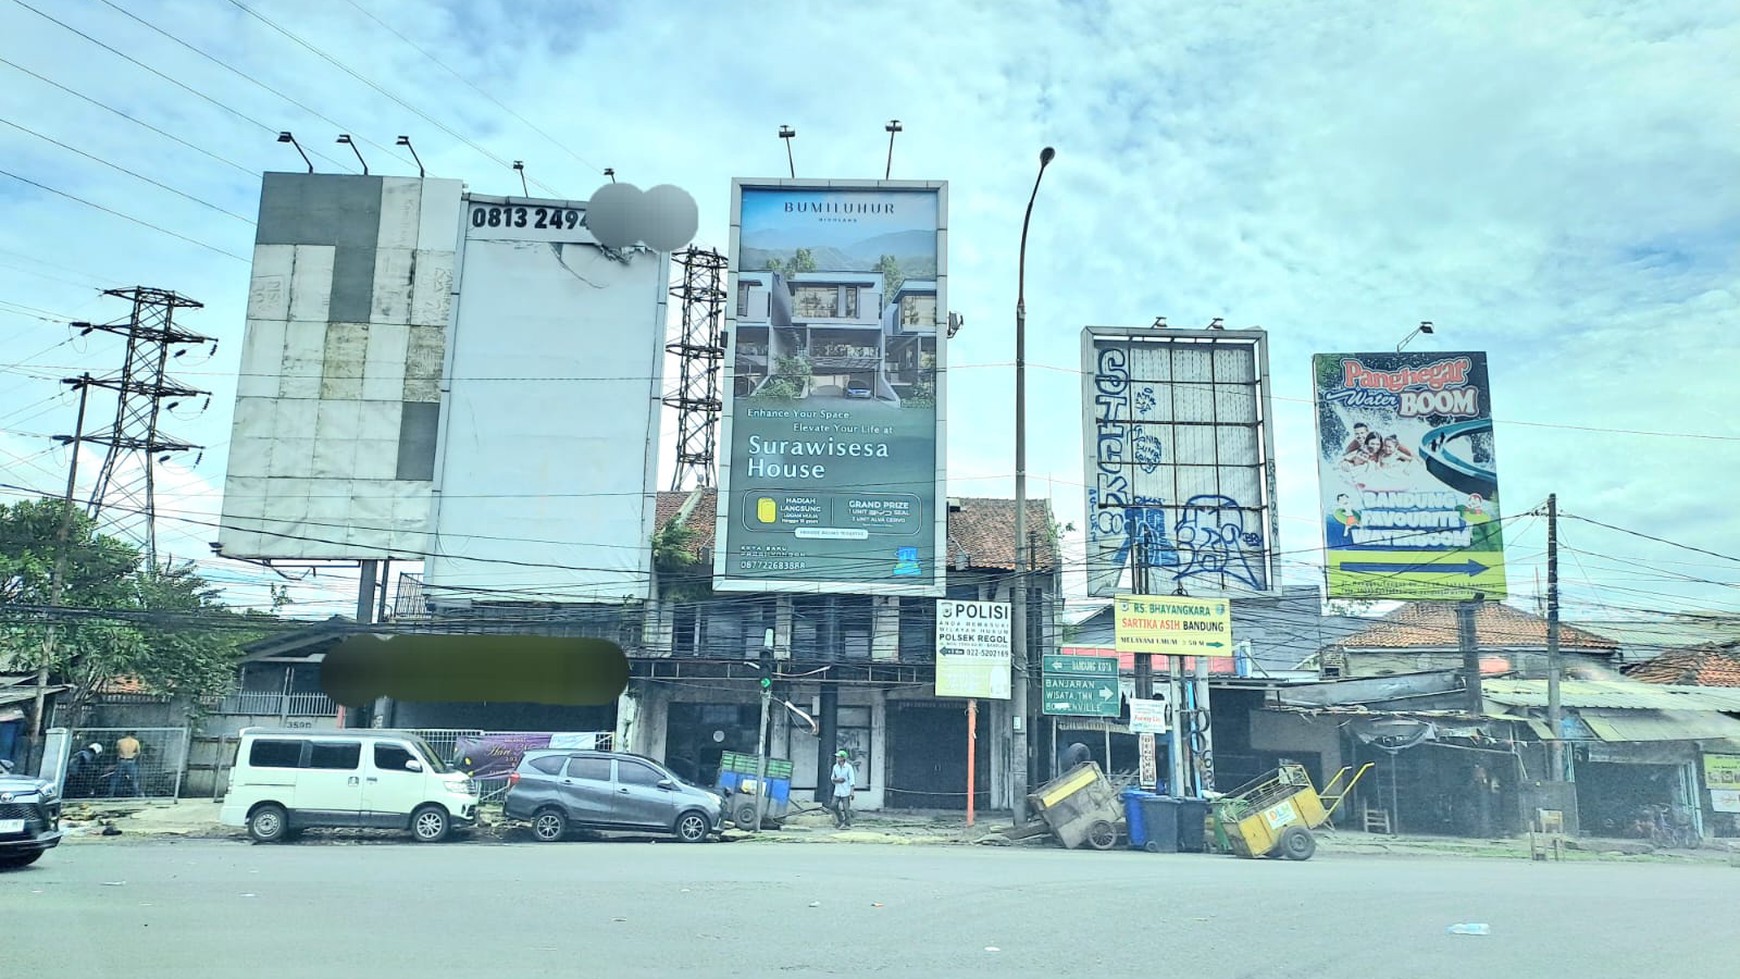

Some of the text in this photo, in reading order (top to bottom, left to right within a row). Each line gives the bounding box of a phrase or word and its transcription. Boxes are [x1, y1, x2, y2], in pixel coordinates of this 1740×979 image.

[784, 201, 895, 214] BUMILUHUR
[472, 207, 527, 228] 0813
[1343, 359, 1469, 392] Panghegar
[1326, 387, 1475, 416] Water BOOM
[747, 409, 789, 418] Enhance
[793, 410, 815, 418] Your
[793, 423, 893, 434] Elevate Your Life at
[749, 435, 889, 457] Surawisesa
[747, 458, 825, 478] House
[849, 500, 909, 509] GRAND PRIZE
[1363, 491, 1457, 509] BANDUNG
[1361, 510, 1461, 528] FAVOURITE
[1352, 528, 1471, 547] WATERBOOM
[955, 603, 1008, 620] POLISI
[1149, 603, 1211, 616] BHAYANGKARA
[1122, 617, 1225, 632] SARTIKA ASIH BANDUNG
[939, 634, 1009, 644] POLSEK REGOL
[1046, 679, 1095, 688] BANJARAN
